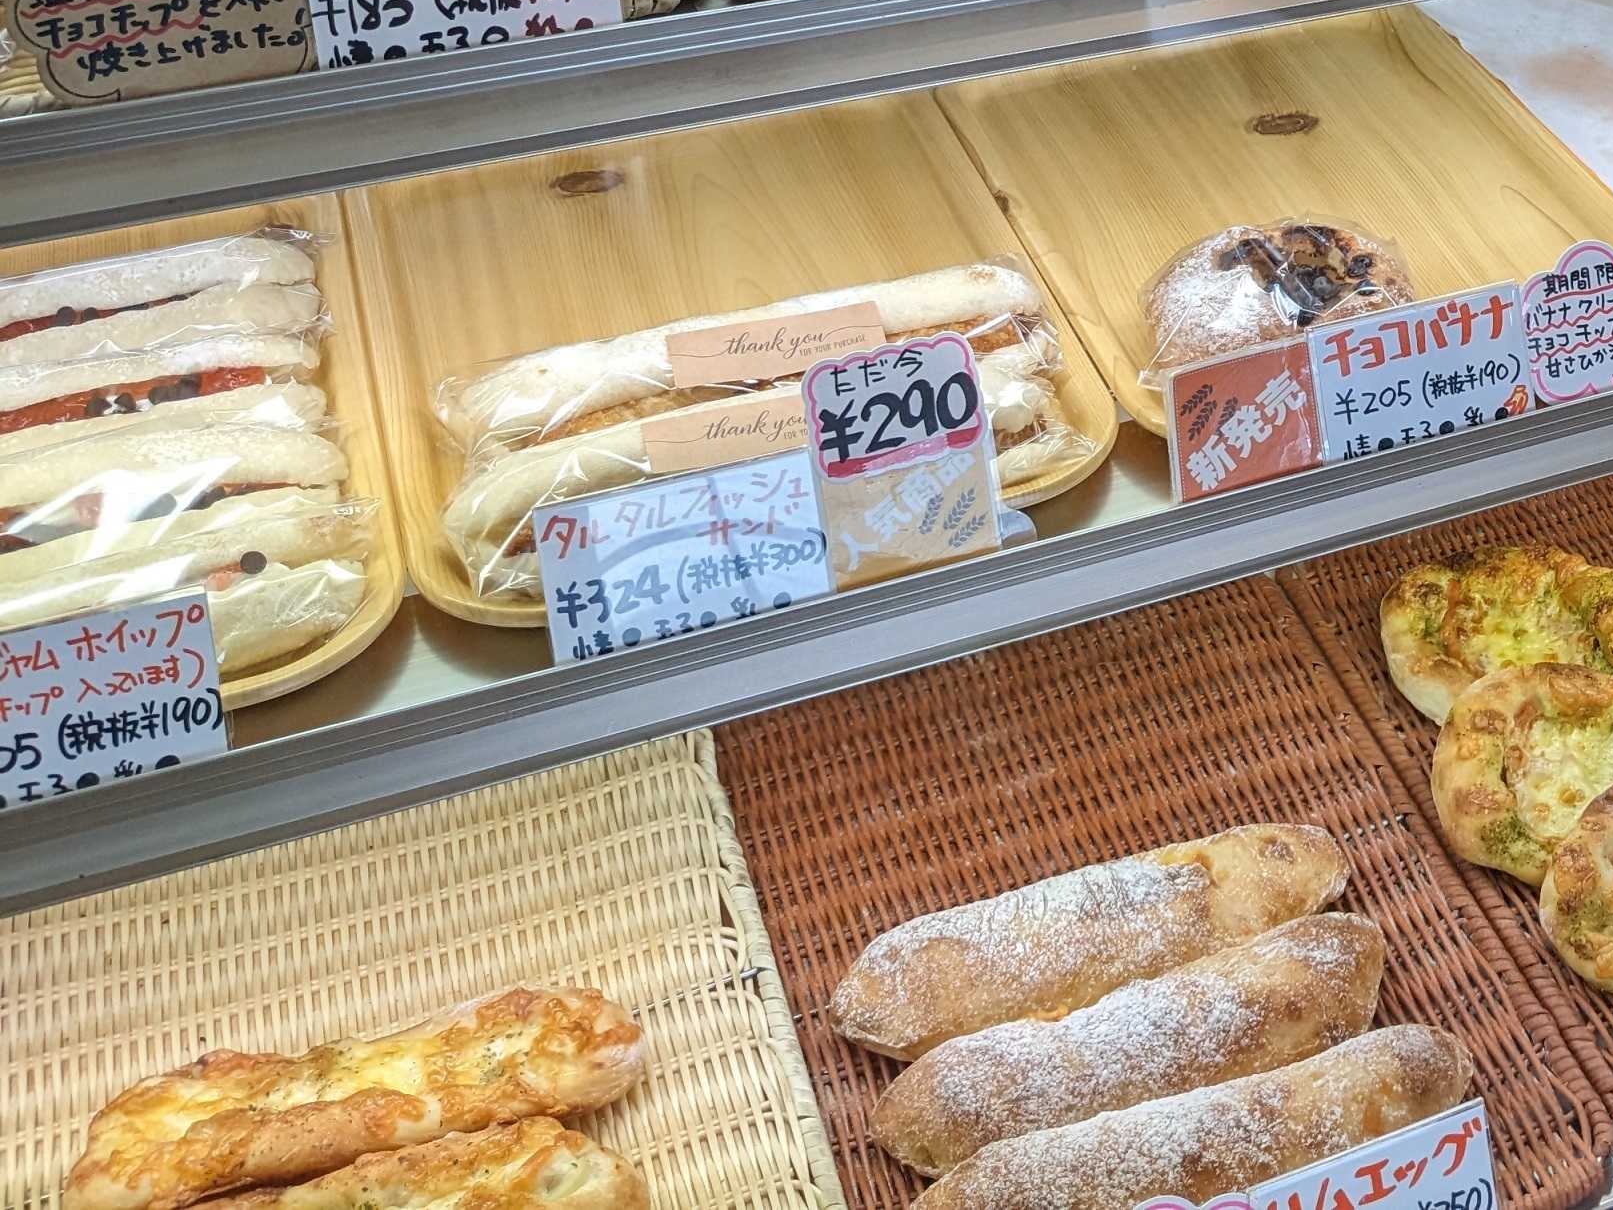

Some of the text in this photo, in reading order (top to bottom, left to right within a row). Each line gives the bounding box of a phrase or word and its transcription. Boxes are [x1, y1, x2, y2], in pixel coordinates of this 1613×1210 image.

[724, 327, 829, 360] thank you
[1323, 294, 1513, 377] チョコバナナ
[830, 349, 923, 396] ただ今
[1334, 380, 1412, 425] ¥205
[703, 410, 772, 441] thank
[819, 371, 979, 464] ¥290
[1186, 370, 1307, 490] 新発売
[540, 469, 808, 559] タルタルフィッシュ
[696, 502, 800, 546] サンド
[841, 452, 976, 571] 人気商品
[555, 564, 670, 629] ¥324
